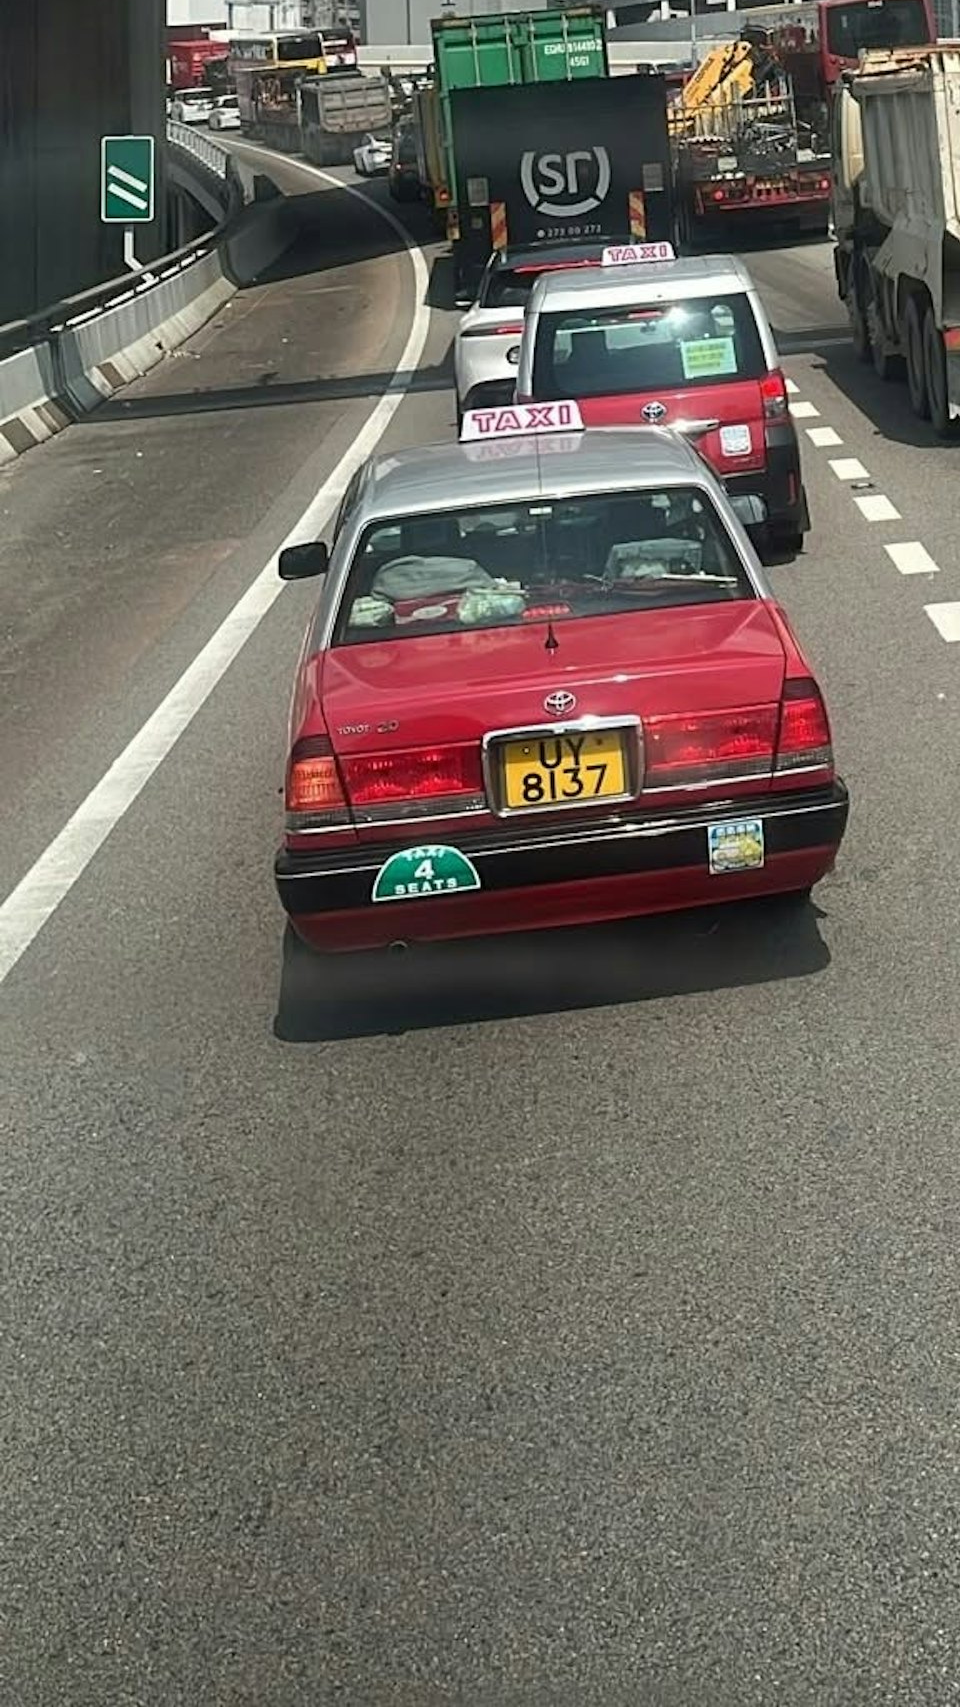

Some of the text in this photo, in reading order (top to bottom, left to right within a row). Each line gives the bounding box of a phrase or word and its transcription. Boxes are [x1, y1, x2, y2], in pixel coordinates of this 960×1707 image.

[607, 245, 669, 262] TAXI
[472, 404, 572, 432] TAXI
[539, 737, 584, 769] UY
[523, 764, 608, 802] 8137
[401, 848, 445, 861] TAXI
[414, 859, 435, 879] 4
[394, 877, 458, 895] SEATS
